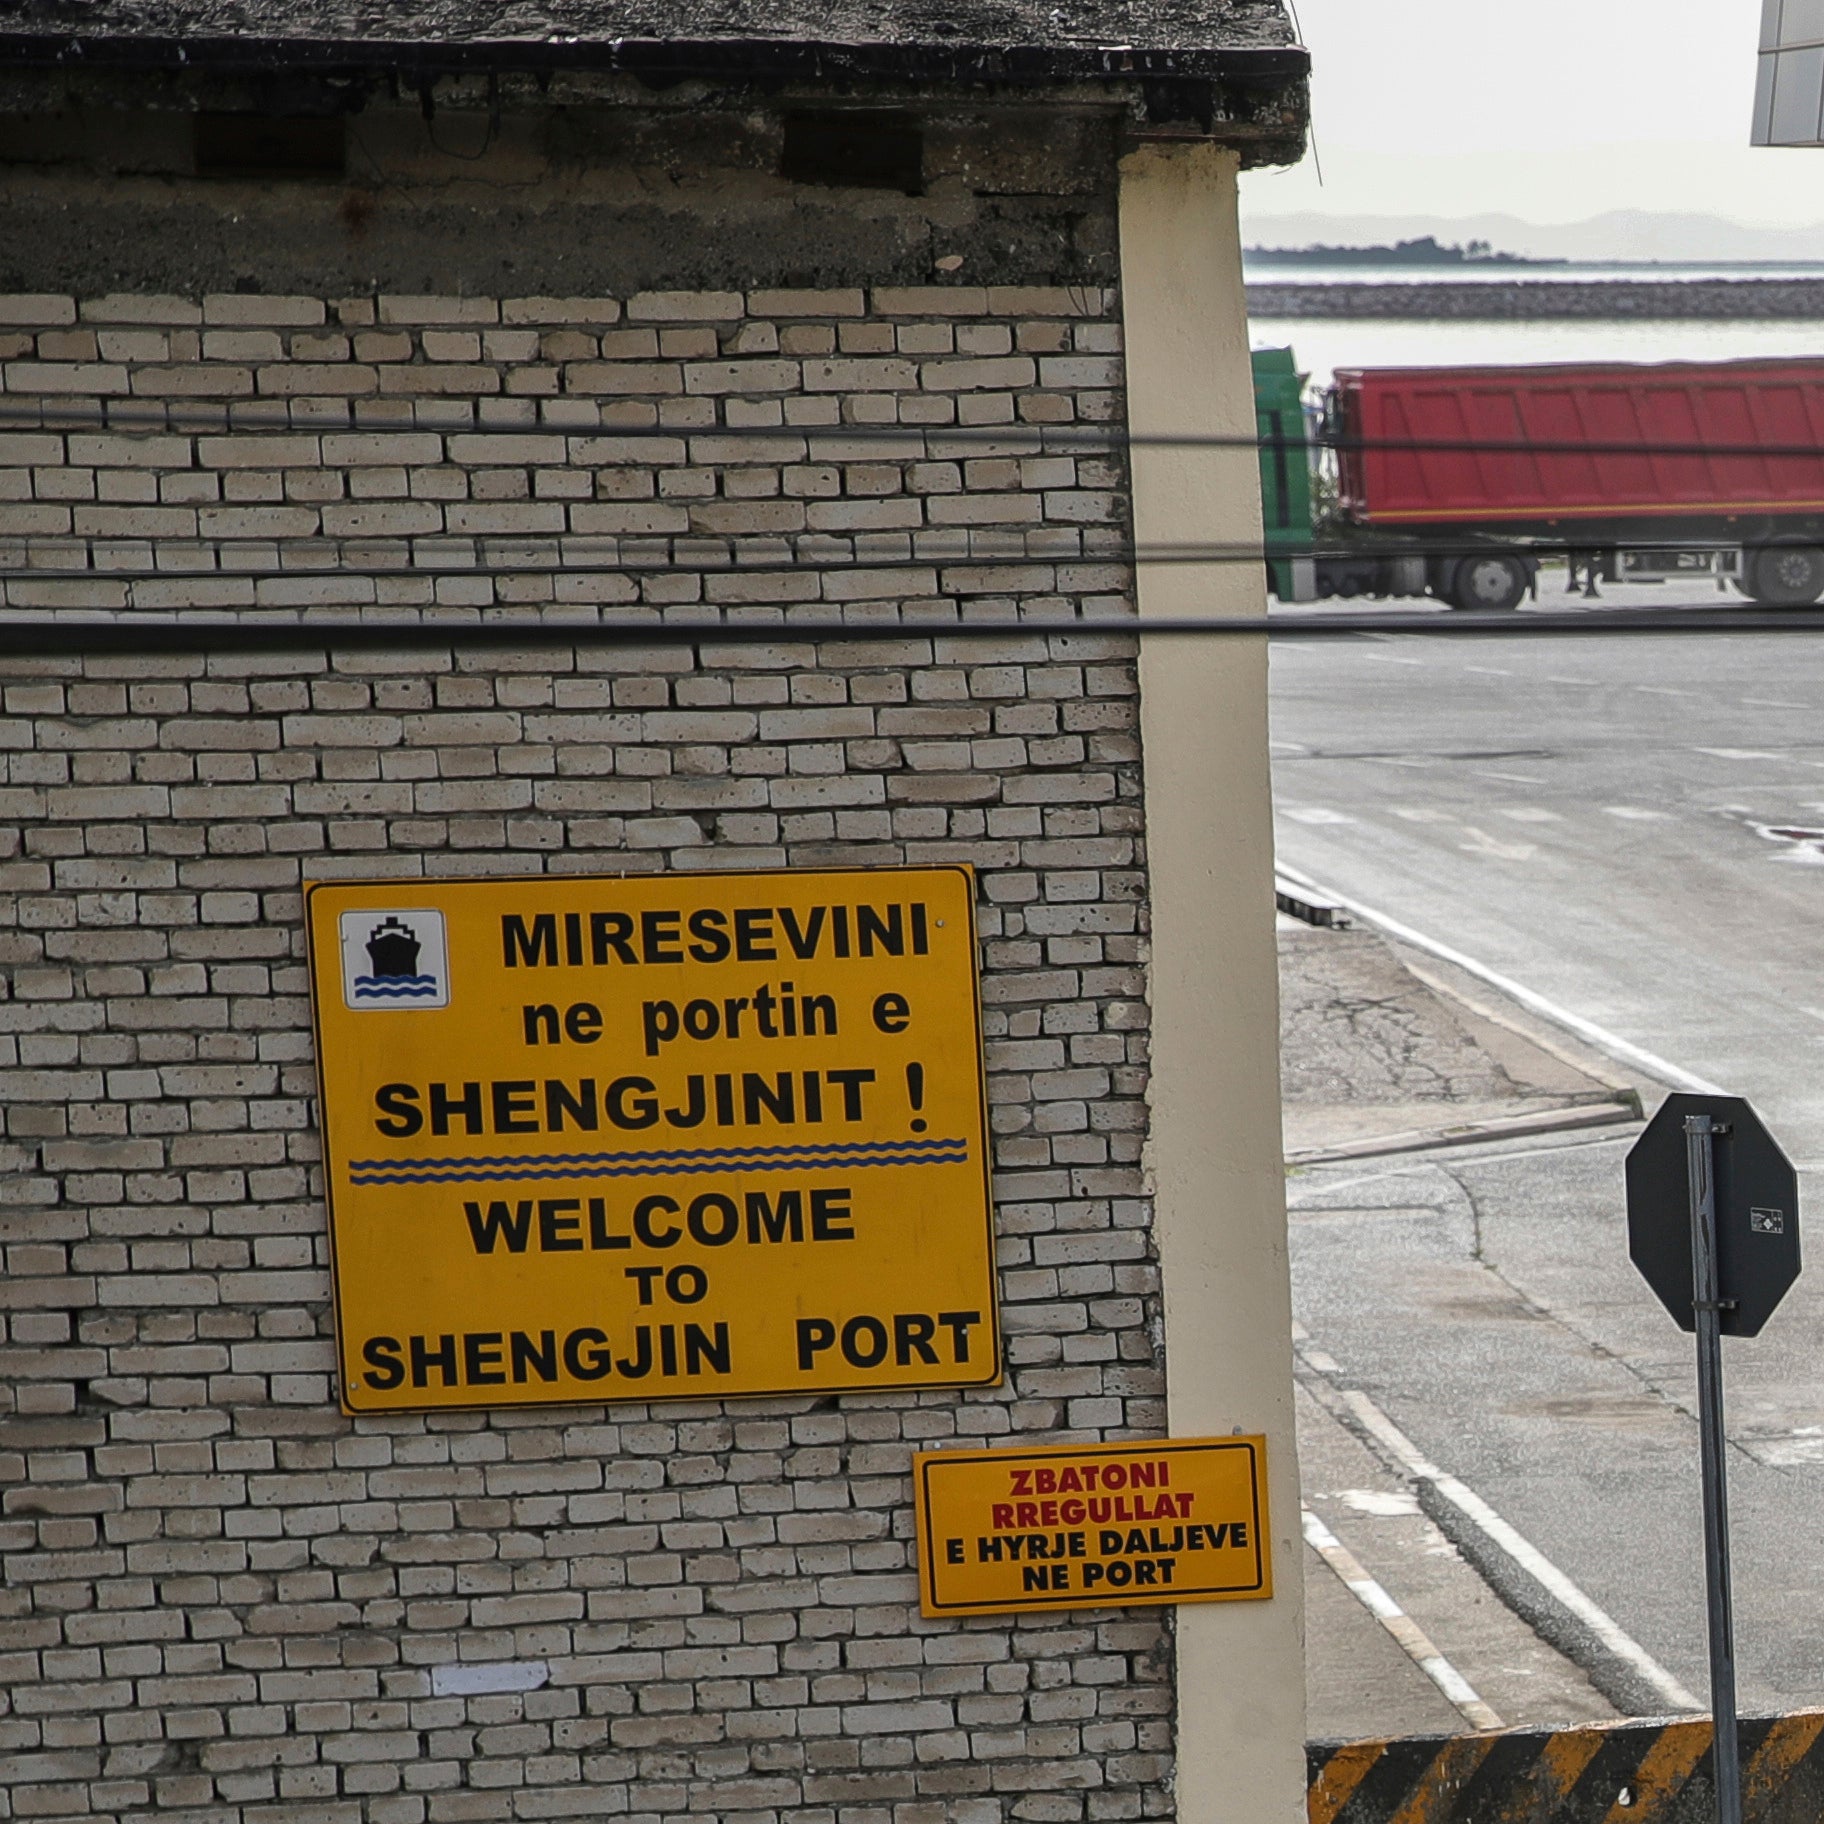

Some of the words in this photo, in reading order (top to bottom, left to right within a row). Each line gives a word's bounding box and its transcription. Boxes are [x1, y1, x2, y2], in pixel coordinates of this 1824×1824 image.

[500, 902, 930, 968] MIRESEVINI
[522, 1002, 604, 1046] ne
[642, 983, 838, 1057] portin
[872, 992, 911, 1034] e
[374, 1068, 876, 1139] SHENGJINIT
[462, 1187, 855, 1255] WELCOME
[624, 1264, 708, 1306] TO
[362, 1321, 732, 1391] SHENGJIN
[795, 1310, 981, 1371] PORT
[1009, 1461, 1169, 1497] ZBATONI
[991, 1492, 1195, 1530] RREGULLAT
[945, 1537, 966, 1565] E
[977, 1531, 1087, 1563] HYRJE
[1098, 1521, 1248, 1556] DALJEVE
[1022, 1563, 1070, 1592] NE
[1081, 1557, 1177, 1589] PORT
